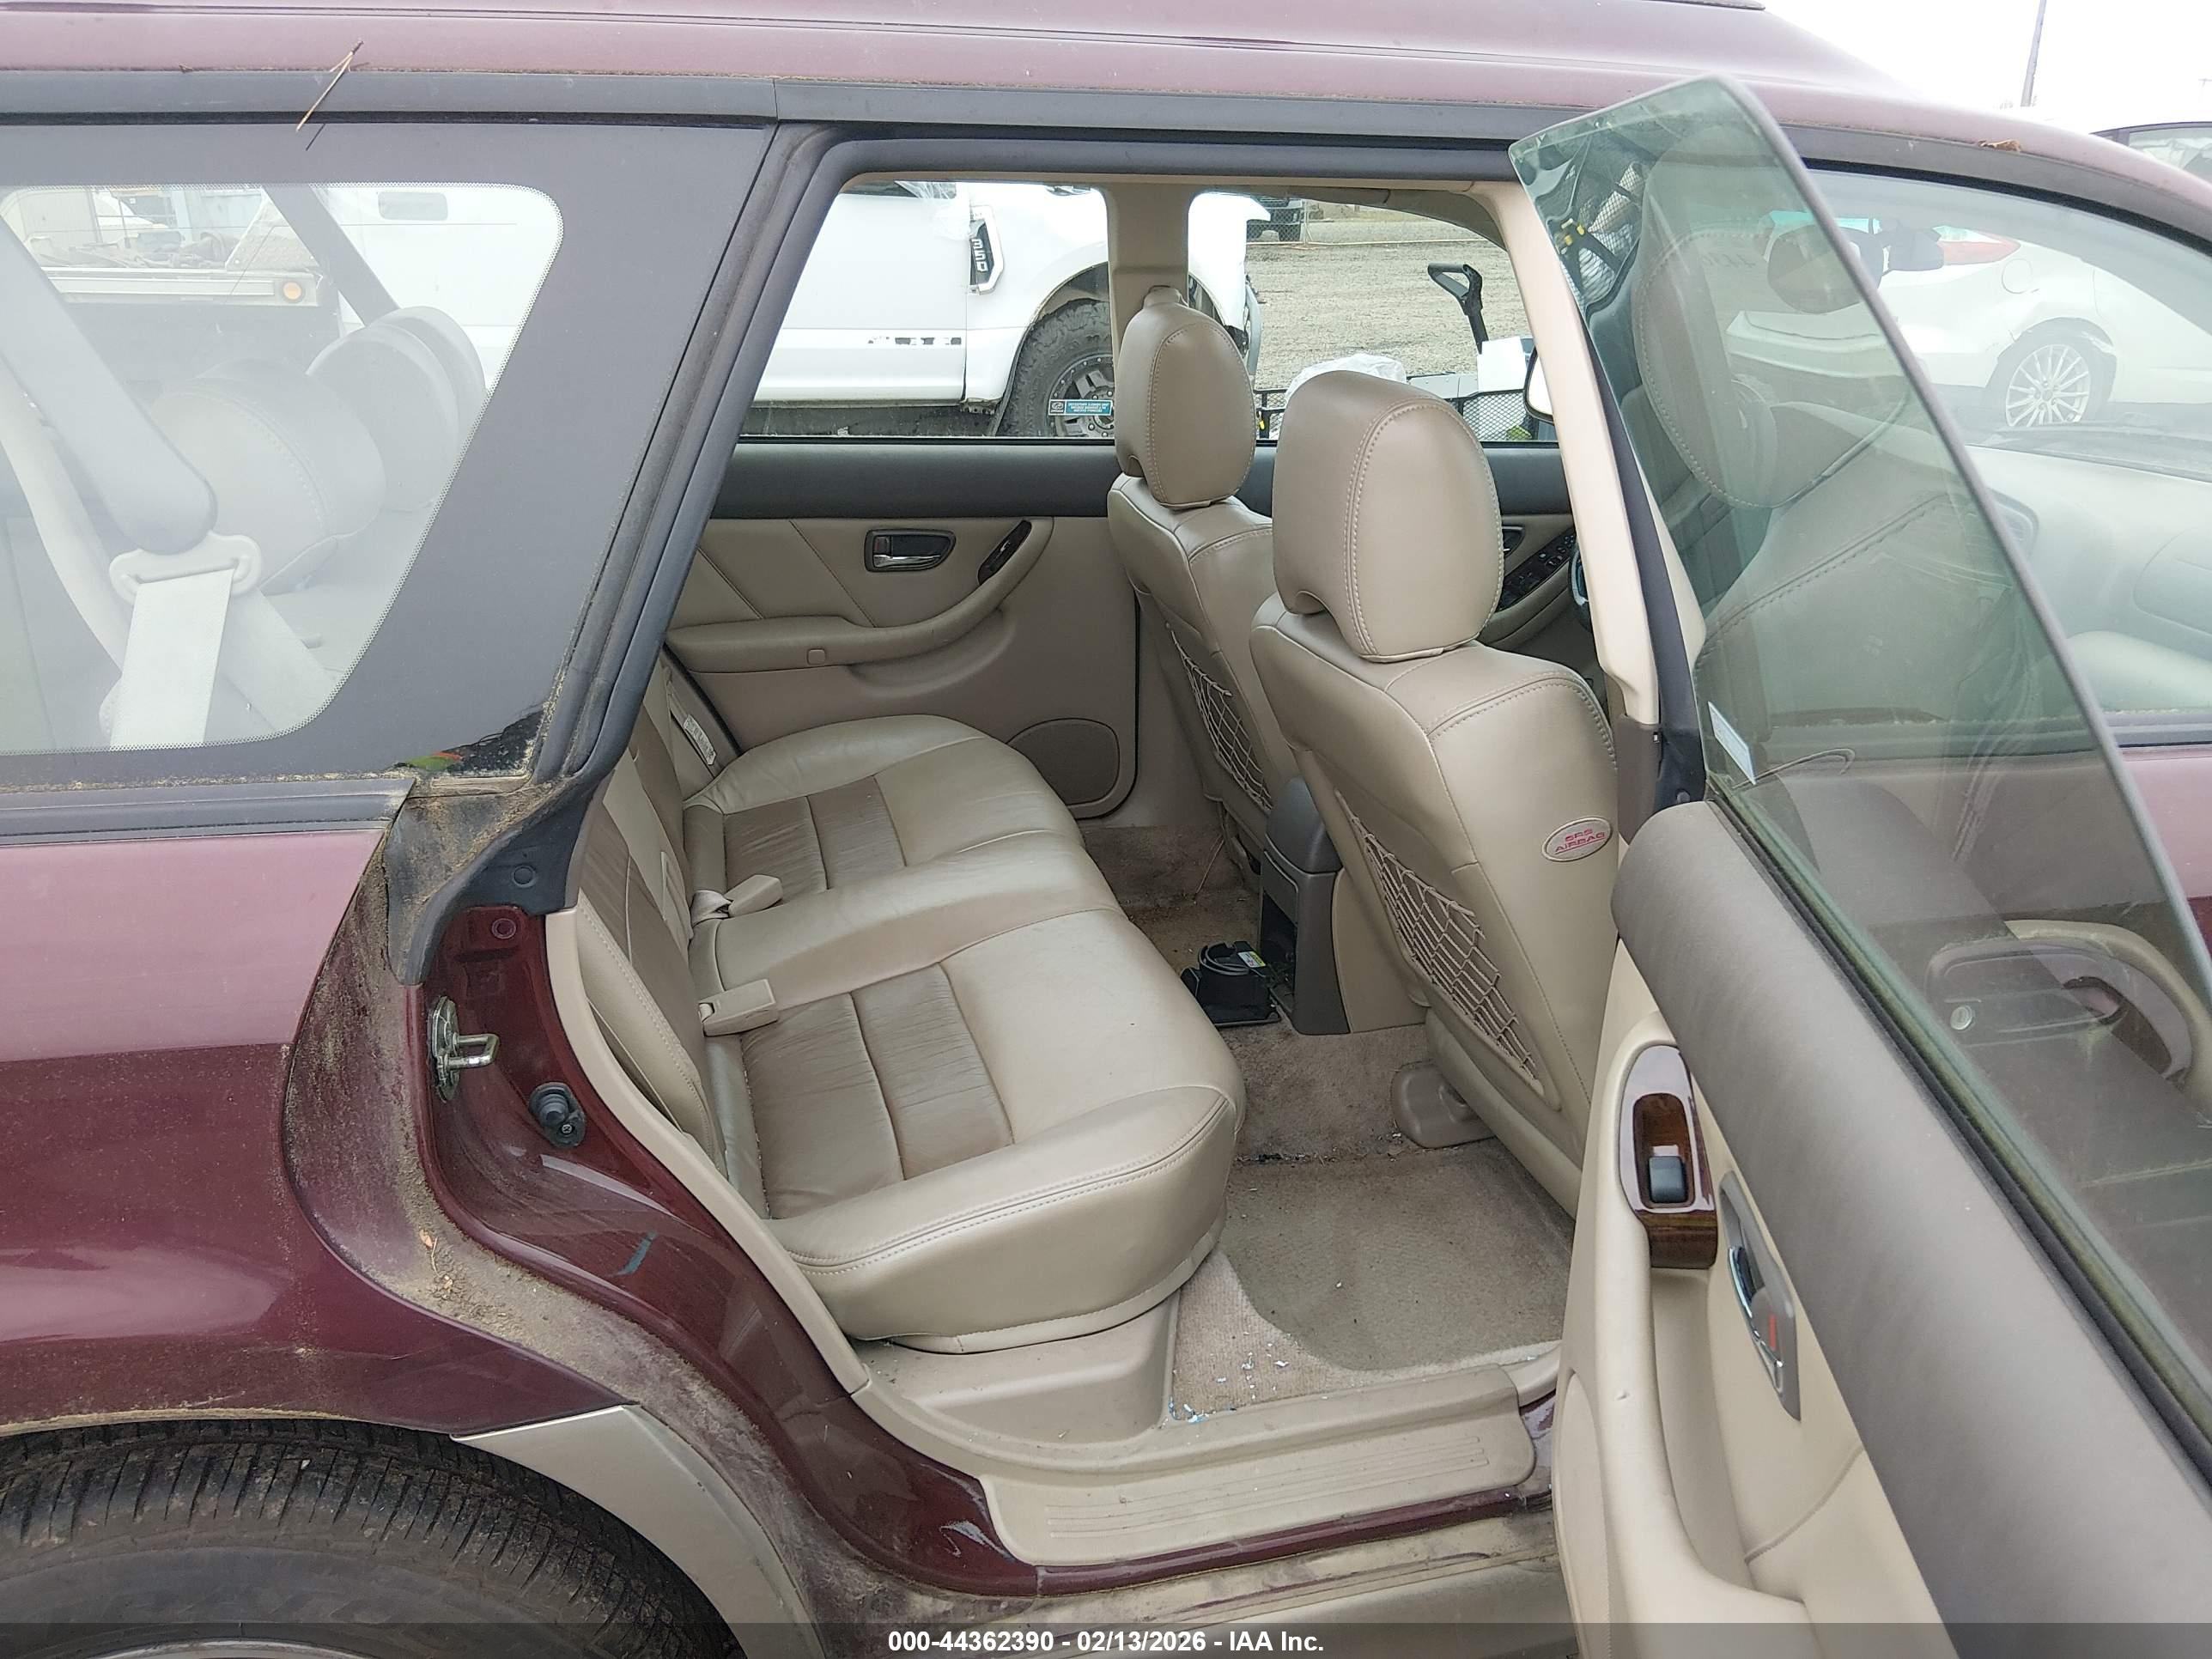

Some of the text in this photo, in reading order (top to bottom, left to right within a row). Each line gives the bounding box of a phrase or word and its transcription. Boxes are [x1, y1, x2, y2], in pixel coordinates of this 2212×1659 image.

[971, 238, 988, 272] 350
[1554, 831, 1606, 852] AIRBAG
[1565, 828, 1593, 842] SRS
